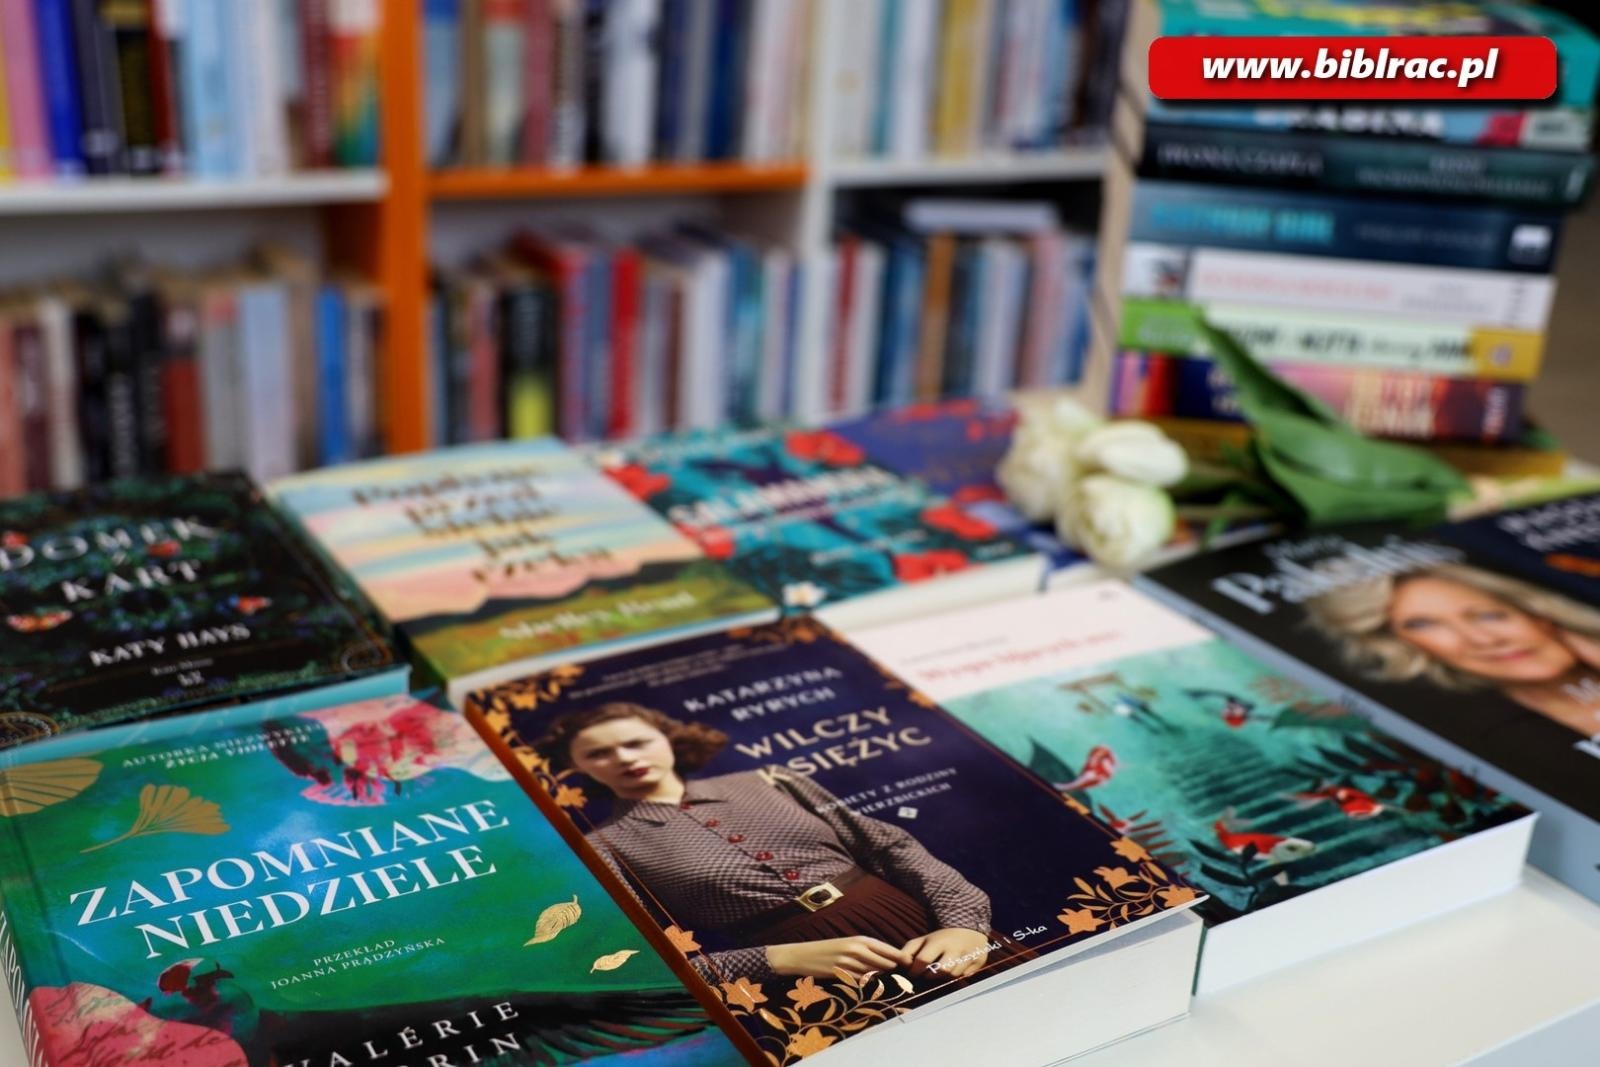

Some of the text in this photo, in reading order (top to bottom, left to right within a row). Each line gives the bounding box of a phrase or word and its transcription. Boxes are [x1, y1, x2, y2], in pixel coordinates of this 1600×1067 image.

[0, 517, 219, 572] DOMEK
[61, 558, 201, 603] KART
[88, 637, 167, 668] KATY
[176, 623, 251, 651] HAYS
[683, 665, 844, 713] KATARZYNA
[730, 686, 837, 723] RYRYCH
[735, 706, 894, 761] WILCZY
[757, 726, 932, 787] KSIĘŻYC
[895, 766, 957, 789] RODZINY
[70, 799, 511, 928] ZAPOMNIANE
[136, 844, 497, 960] NIEDZIELE
[313, 939, 395, 967] PRZEKŁAD
[1013, 924, 1048, 942] S-ka
[270, 937, 445, 990] JOANNA PRĄDZYŃSKA
